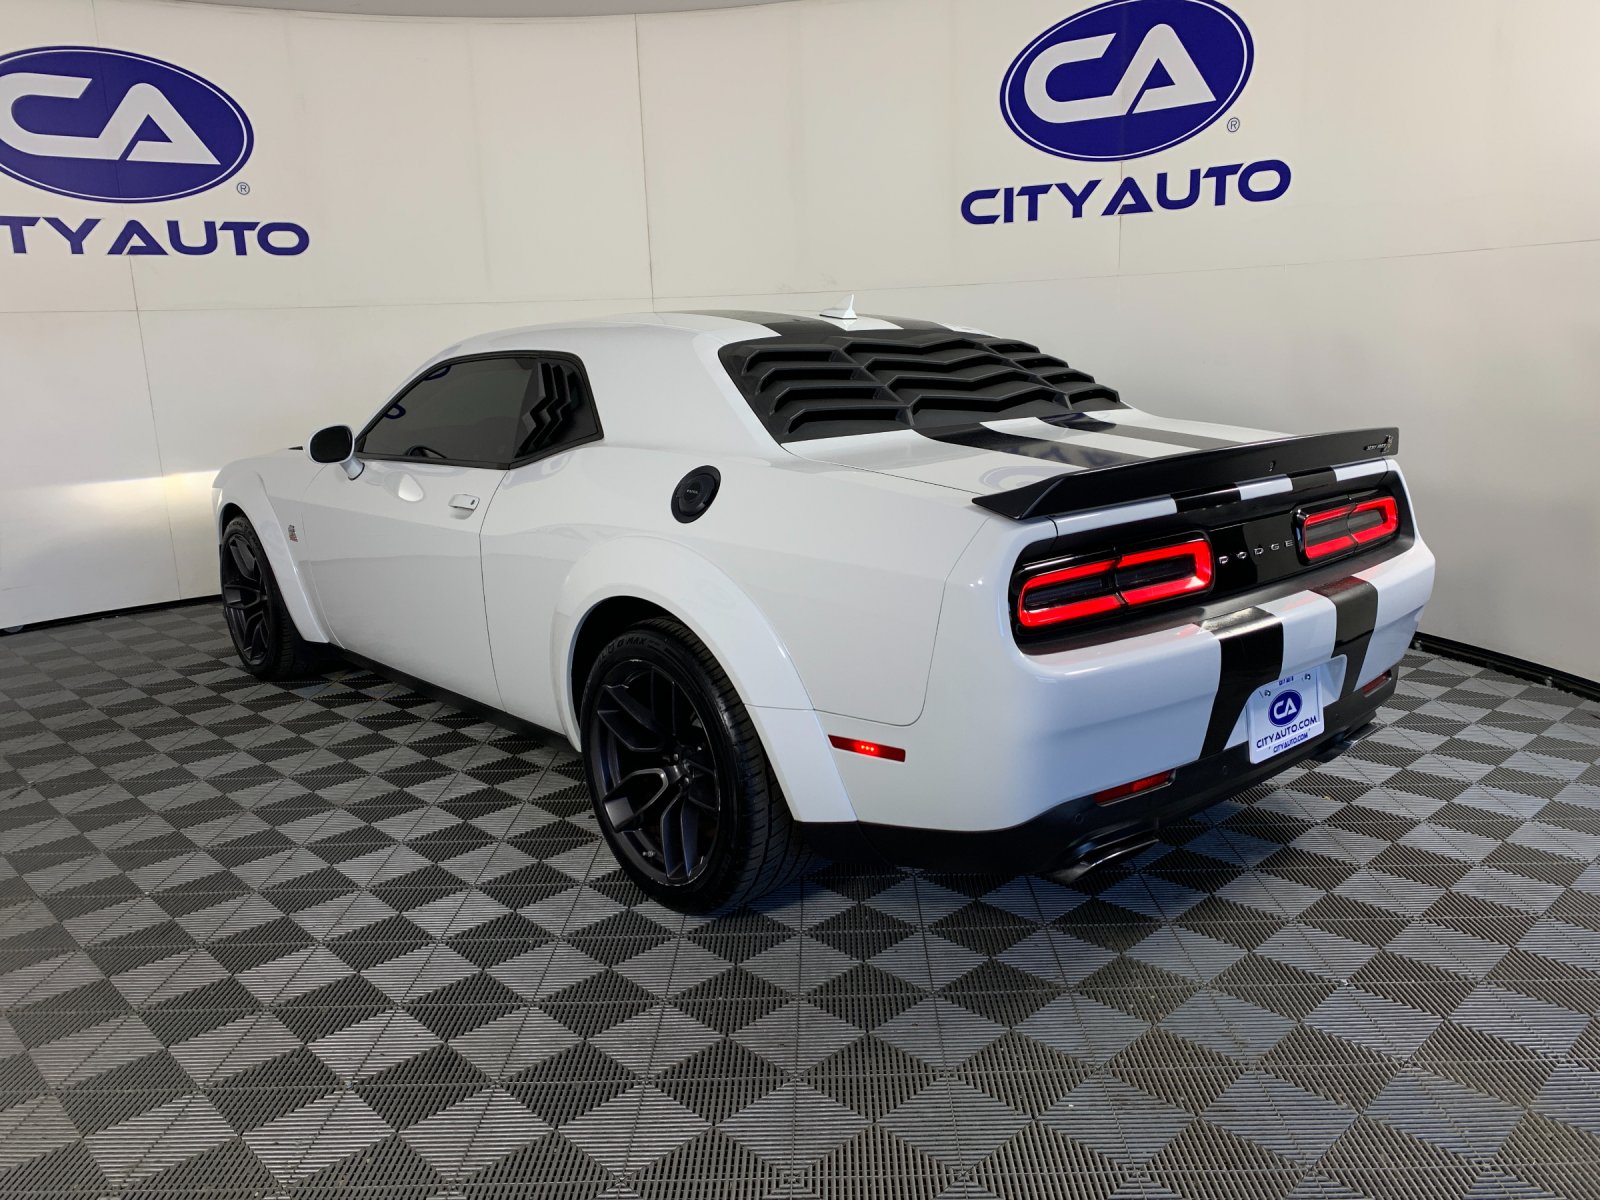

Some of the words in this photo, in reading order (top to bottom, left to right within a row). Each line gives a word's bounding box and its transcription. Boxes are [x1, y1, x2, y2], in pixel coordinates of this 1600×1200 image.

[1023, 23, 1217, 124] CA
[0, 72, 221, 165] CA
[1218, 540, 1294, 564] DODGE
[1273, 697, 1298, 720] CA
[1256, 715, 1317, 749] CITYAUTO.COM
